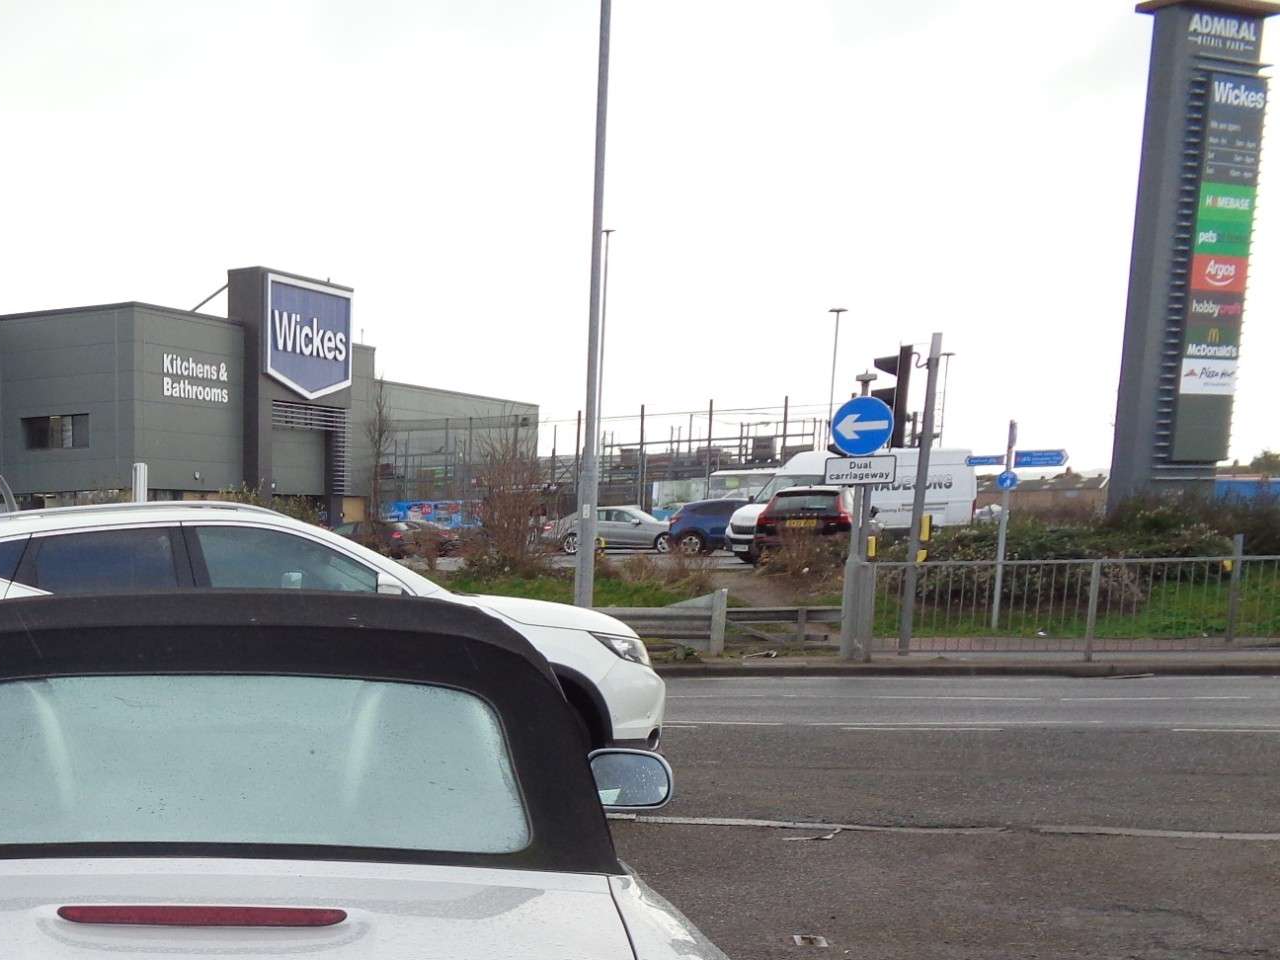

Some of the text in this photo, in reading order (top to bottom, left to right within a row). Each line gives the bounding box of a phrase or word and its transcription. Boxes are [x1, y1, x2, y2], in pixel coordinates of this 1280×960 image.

[1189, 13, 1257, 41] ADMIRAL
[1214, 80, 1265, 109] Wickes
[1198, 230, 1217, 245] pets
[1206, 259, 1236, 279] Argos
[274, 309, 346, 362] Wickes
[163, 353, 228, 382] Kitchens &
[163, 377, 228, 403] Bathrooms
[828, 471, 891, 481] carriageway
[849, 461, 872, 470] Dual
